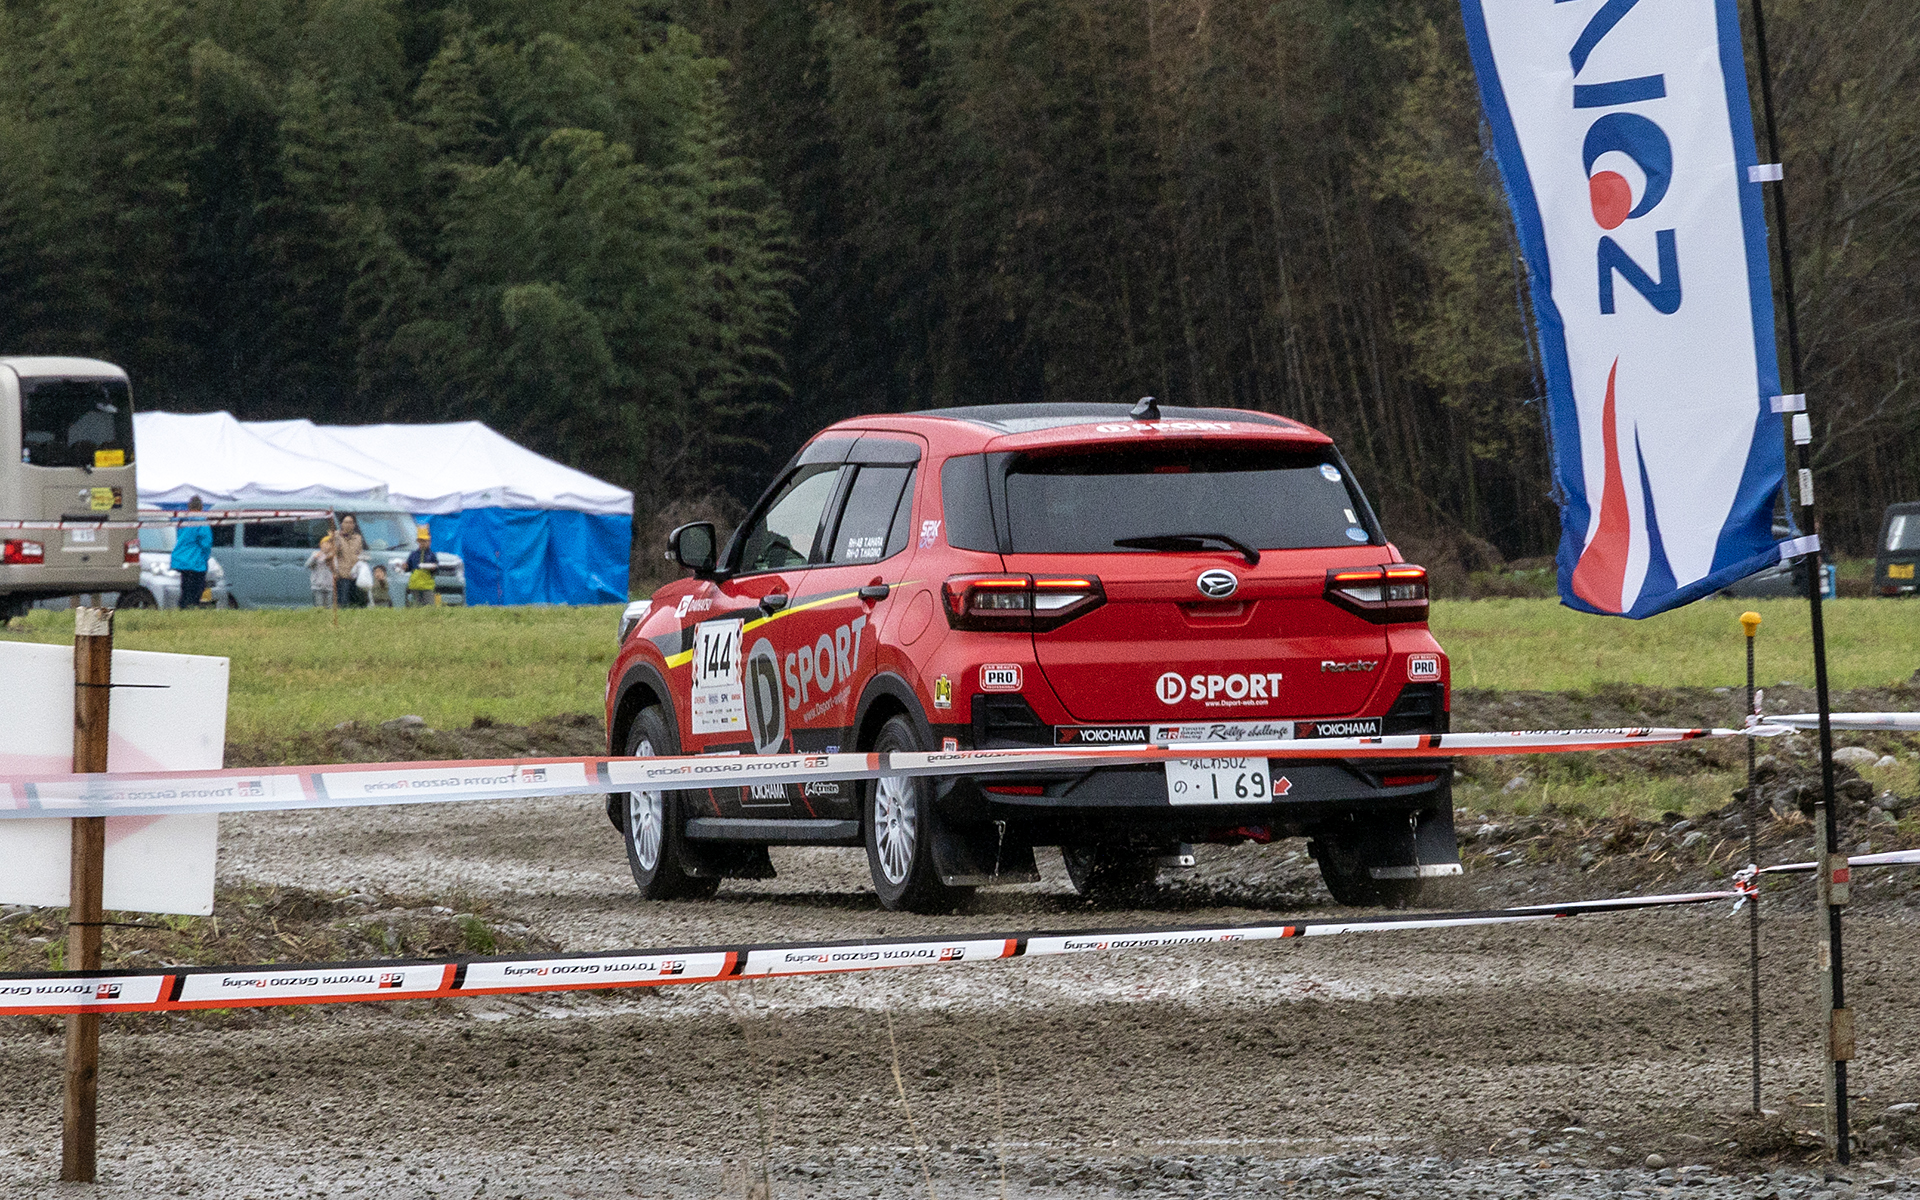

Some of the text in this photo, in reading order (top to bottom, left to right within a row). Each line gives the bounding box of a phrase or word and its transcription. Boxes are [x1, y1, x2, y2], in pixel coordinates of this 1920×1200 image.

[921, 520, 942, 537] SPK
[703, 631, 732, 680] 144
[784, 614, 867, 711] SPORT
[1320, 660, 1378, 674] Rocky
[1414, 661, 1434, 673] PRO
[988, 671, 1014, 684] PRO
[1190, 673, 1282, 700] SPORT
[1207, 724, 1246, 741] Rally
[1316, 721, 1377, 736] YOKOHAMA
[1079, 729, 1146, 742] YOKOHAMA
[1064, 941, 1109, 951] Racing
[785, 953, 829, 964] Racing
[831, 951, 879, 962] GAZOO
[884, 949, 937, 960] TOYOTA
[504, 965, 549, 977] Racing
[552, 965, 600, 975] GAZOO
[603, 962, 657, 973] TOYOTA
[222, 977, 267, 988] Racing
[270, 976, 319, 987] GAZOO
[323, 974, 376, 985] TOYOTA
[36, 984, 93, 995] TOYOTA
